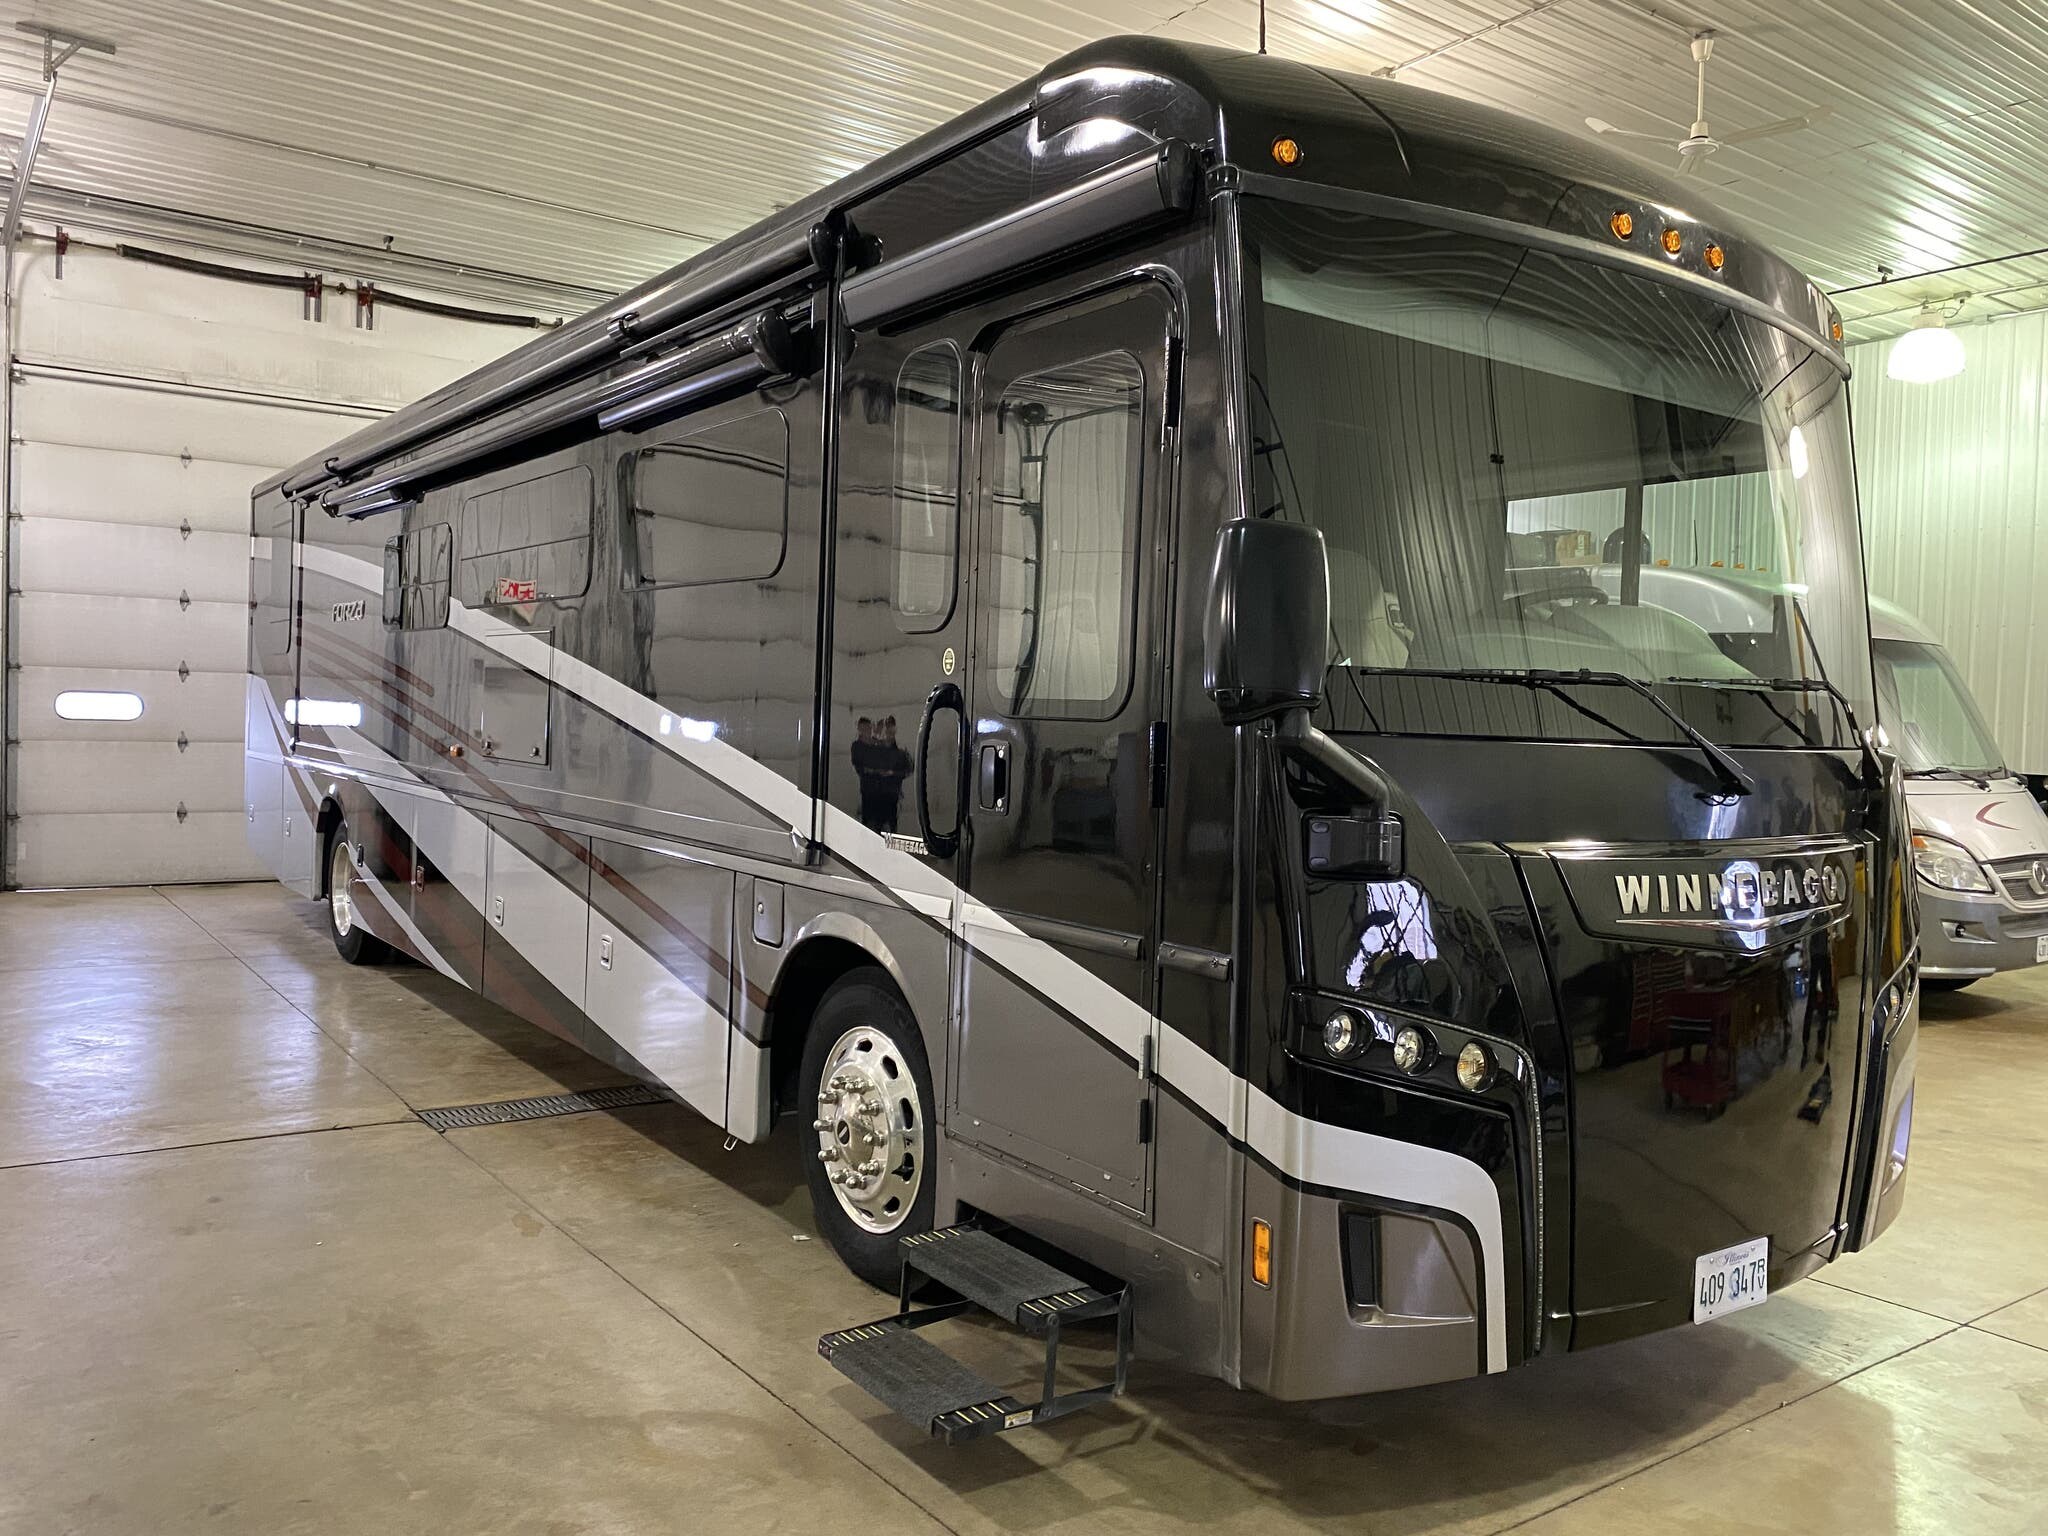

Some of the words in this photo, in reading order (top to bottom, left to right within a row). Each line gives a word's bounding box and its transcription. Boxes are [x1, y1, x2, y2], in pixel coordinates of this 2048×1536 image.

[1614, 864, 1838, 915] WINNEBAGO
[1699, 1271, 1725, 1307] 409
[1731, 1261, 1757, 1298] 347
